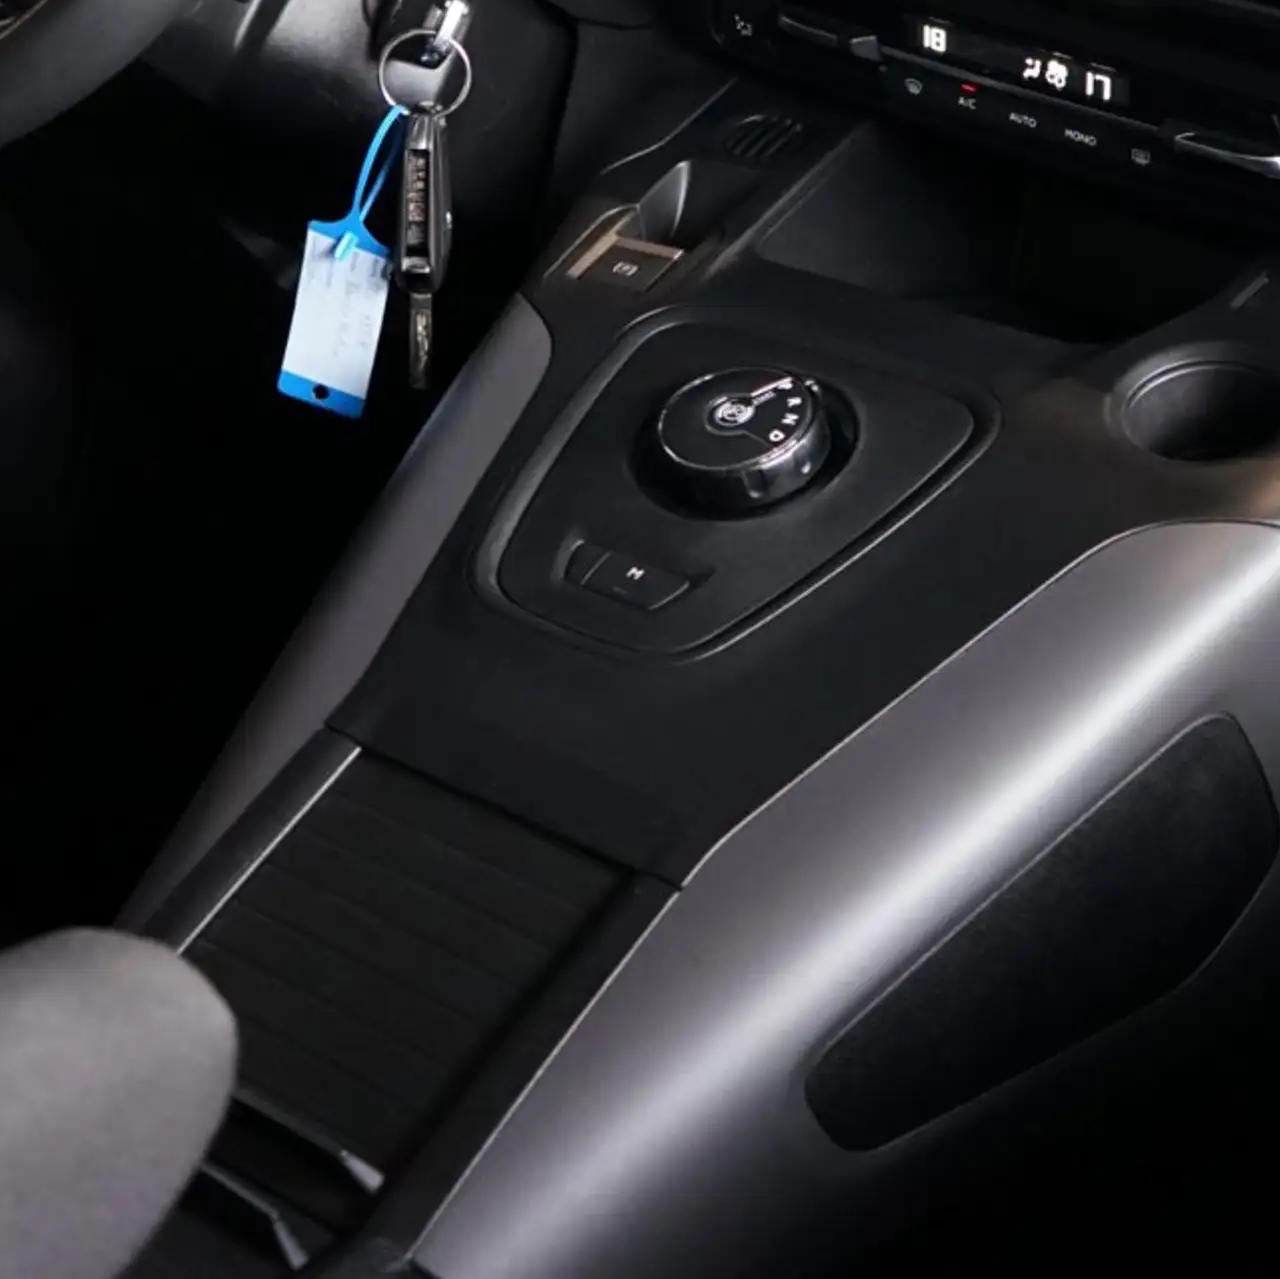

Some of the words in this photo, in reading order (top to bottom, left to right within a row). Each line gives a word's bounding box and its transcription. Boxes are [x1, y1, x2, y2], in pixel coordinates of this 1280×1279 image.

[923, 25, 947, 52] 18
[1009, 112, 1037, 129] AUTO
[1064, 128, 1098, 147] MONO
